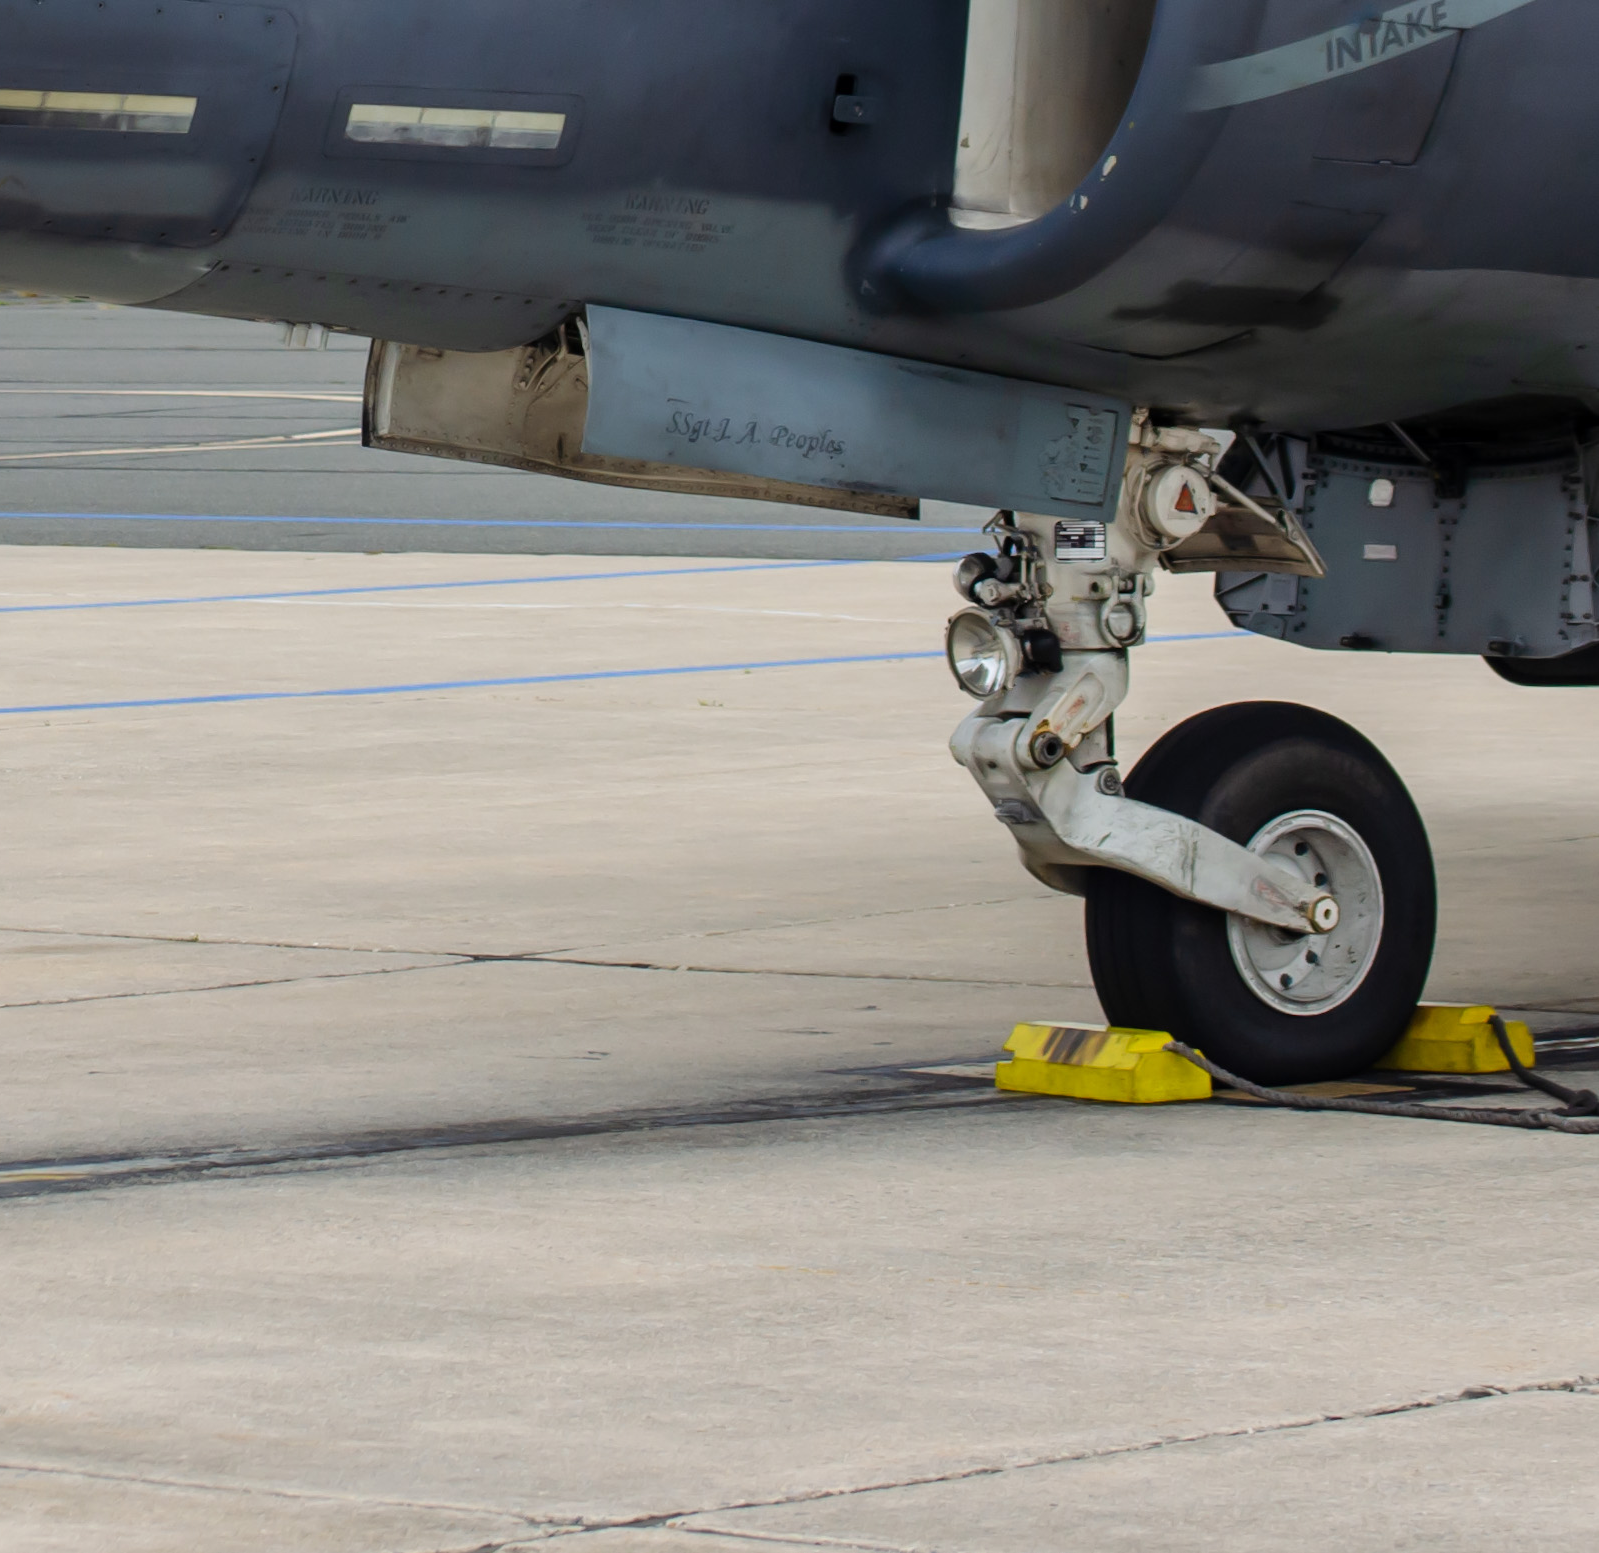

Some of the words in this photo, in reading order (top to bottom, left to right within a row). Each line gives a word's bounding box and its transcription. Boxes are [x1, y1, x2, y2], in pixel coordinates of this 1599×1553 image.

[290, 187, 379, 205] WARNING
[625, 193, 710, 215] WARNING
[666, 410, 711, 443] SSgt
[769, 425, 846, 458] Peoples
